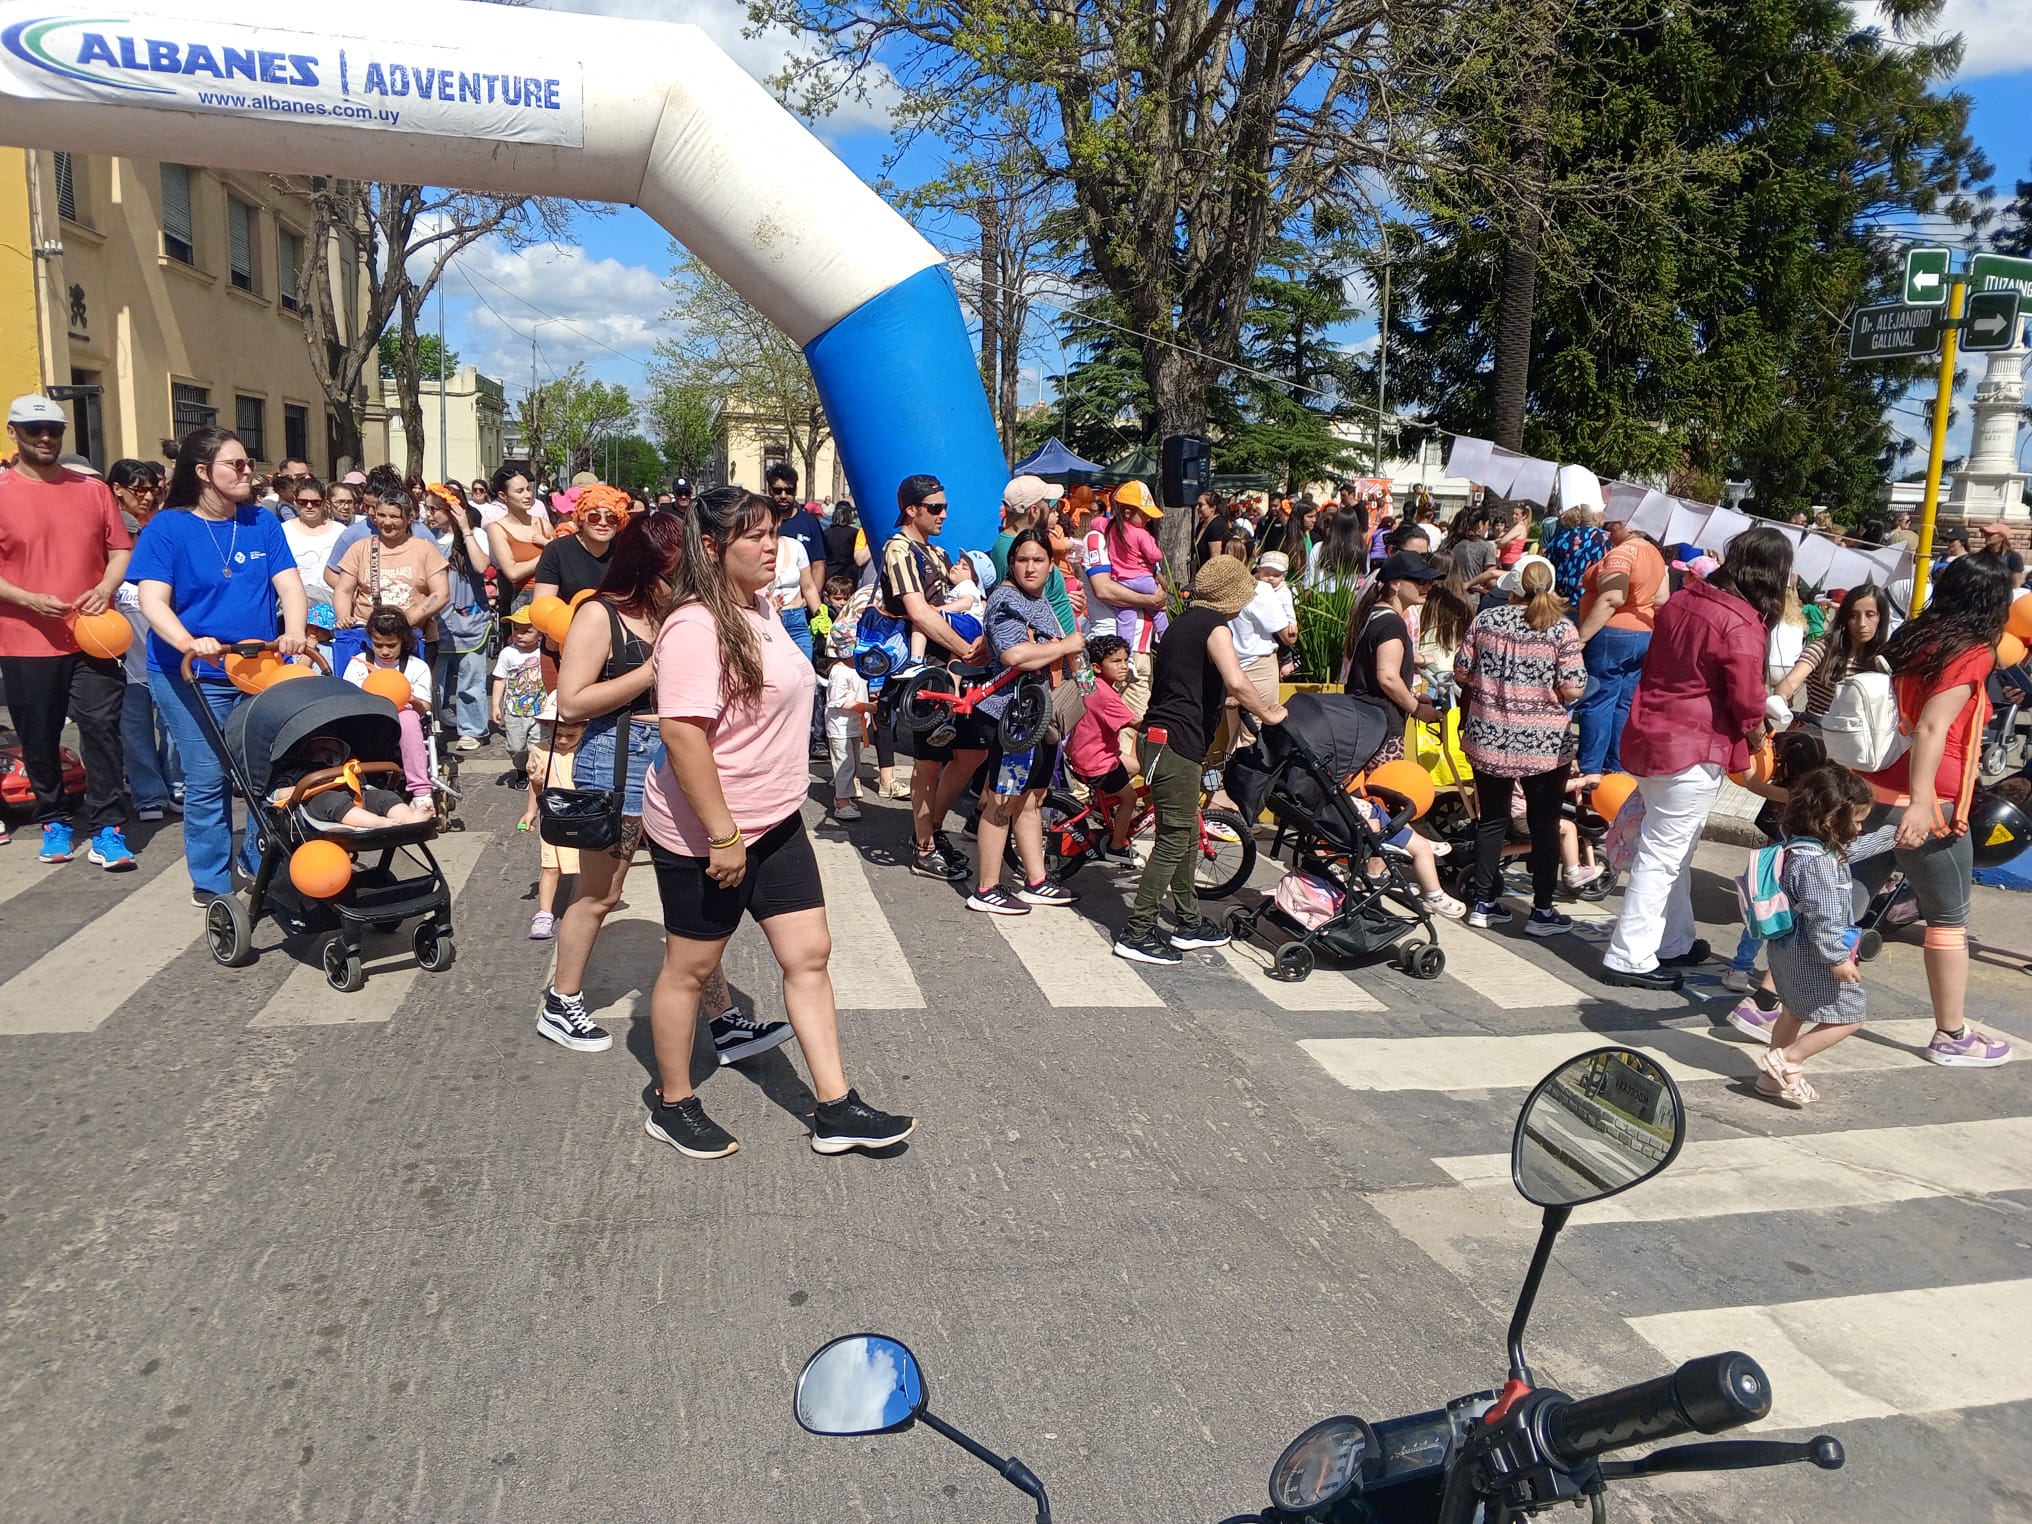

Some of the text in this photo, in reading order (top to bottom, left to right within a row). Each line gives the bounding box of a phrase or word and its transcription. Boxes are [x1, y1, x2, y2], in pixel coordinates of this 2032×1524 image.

[76, 31, 561, 110] ALBANES ADVENTURE
[198, 91, 400, 125] www.albanes.com.uy
[1861, 309, 1932, 334] Dr. ALEJANDRO
[1871, 330, 1915, 350] GALLINAL
